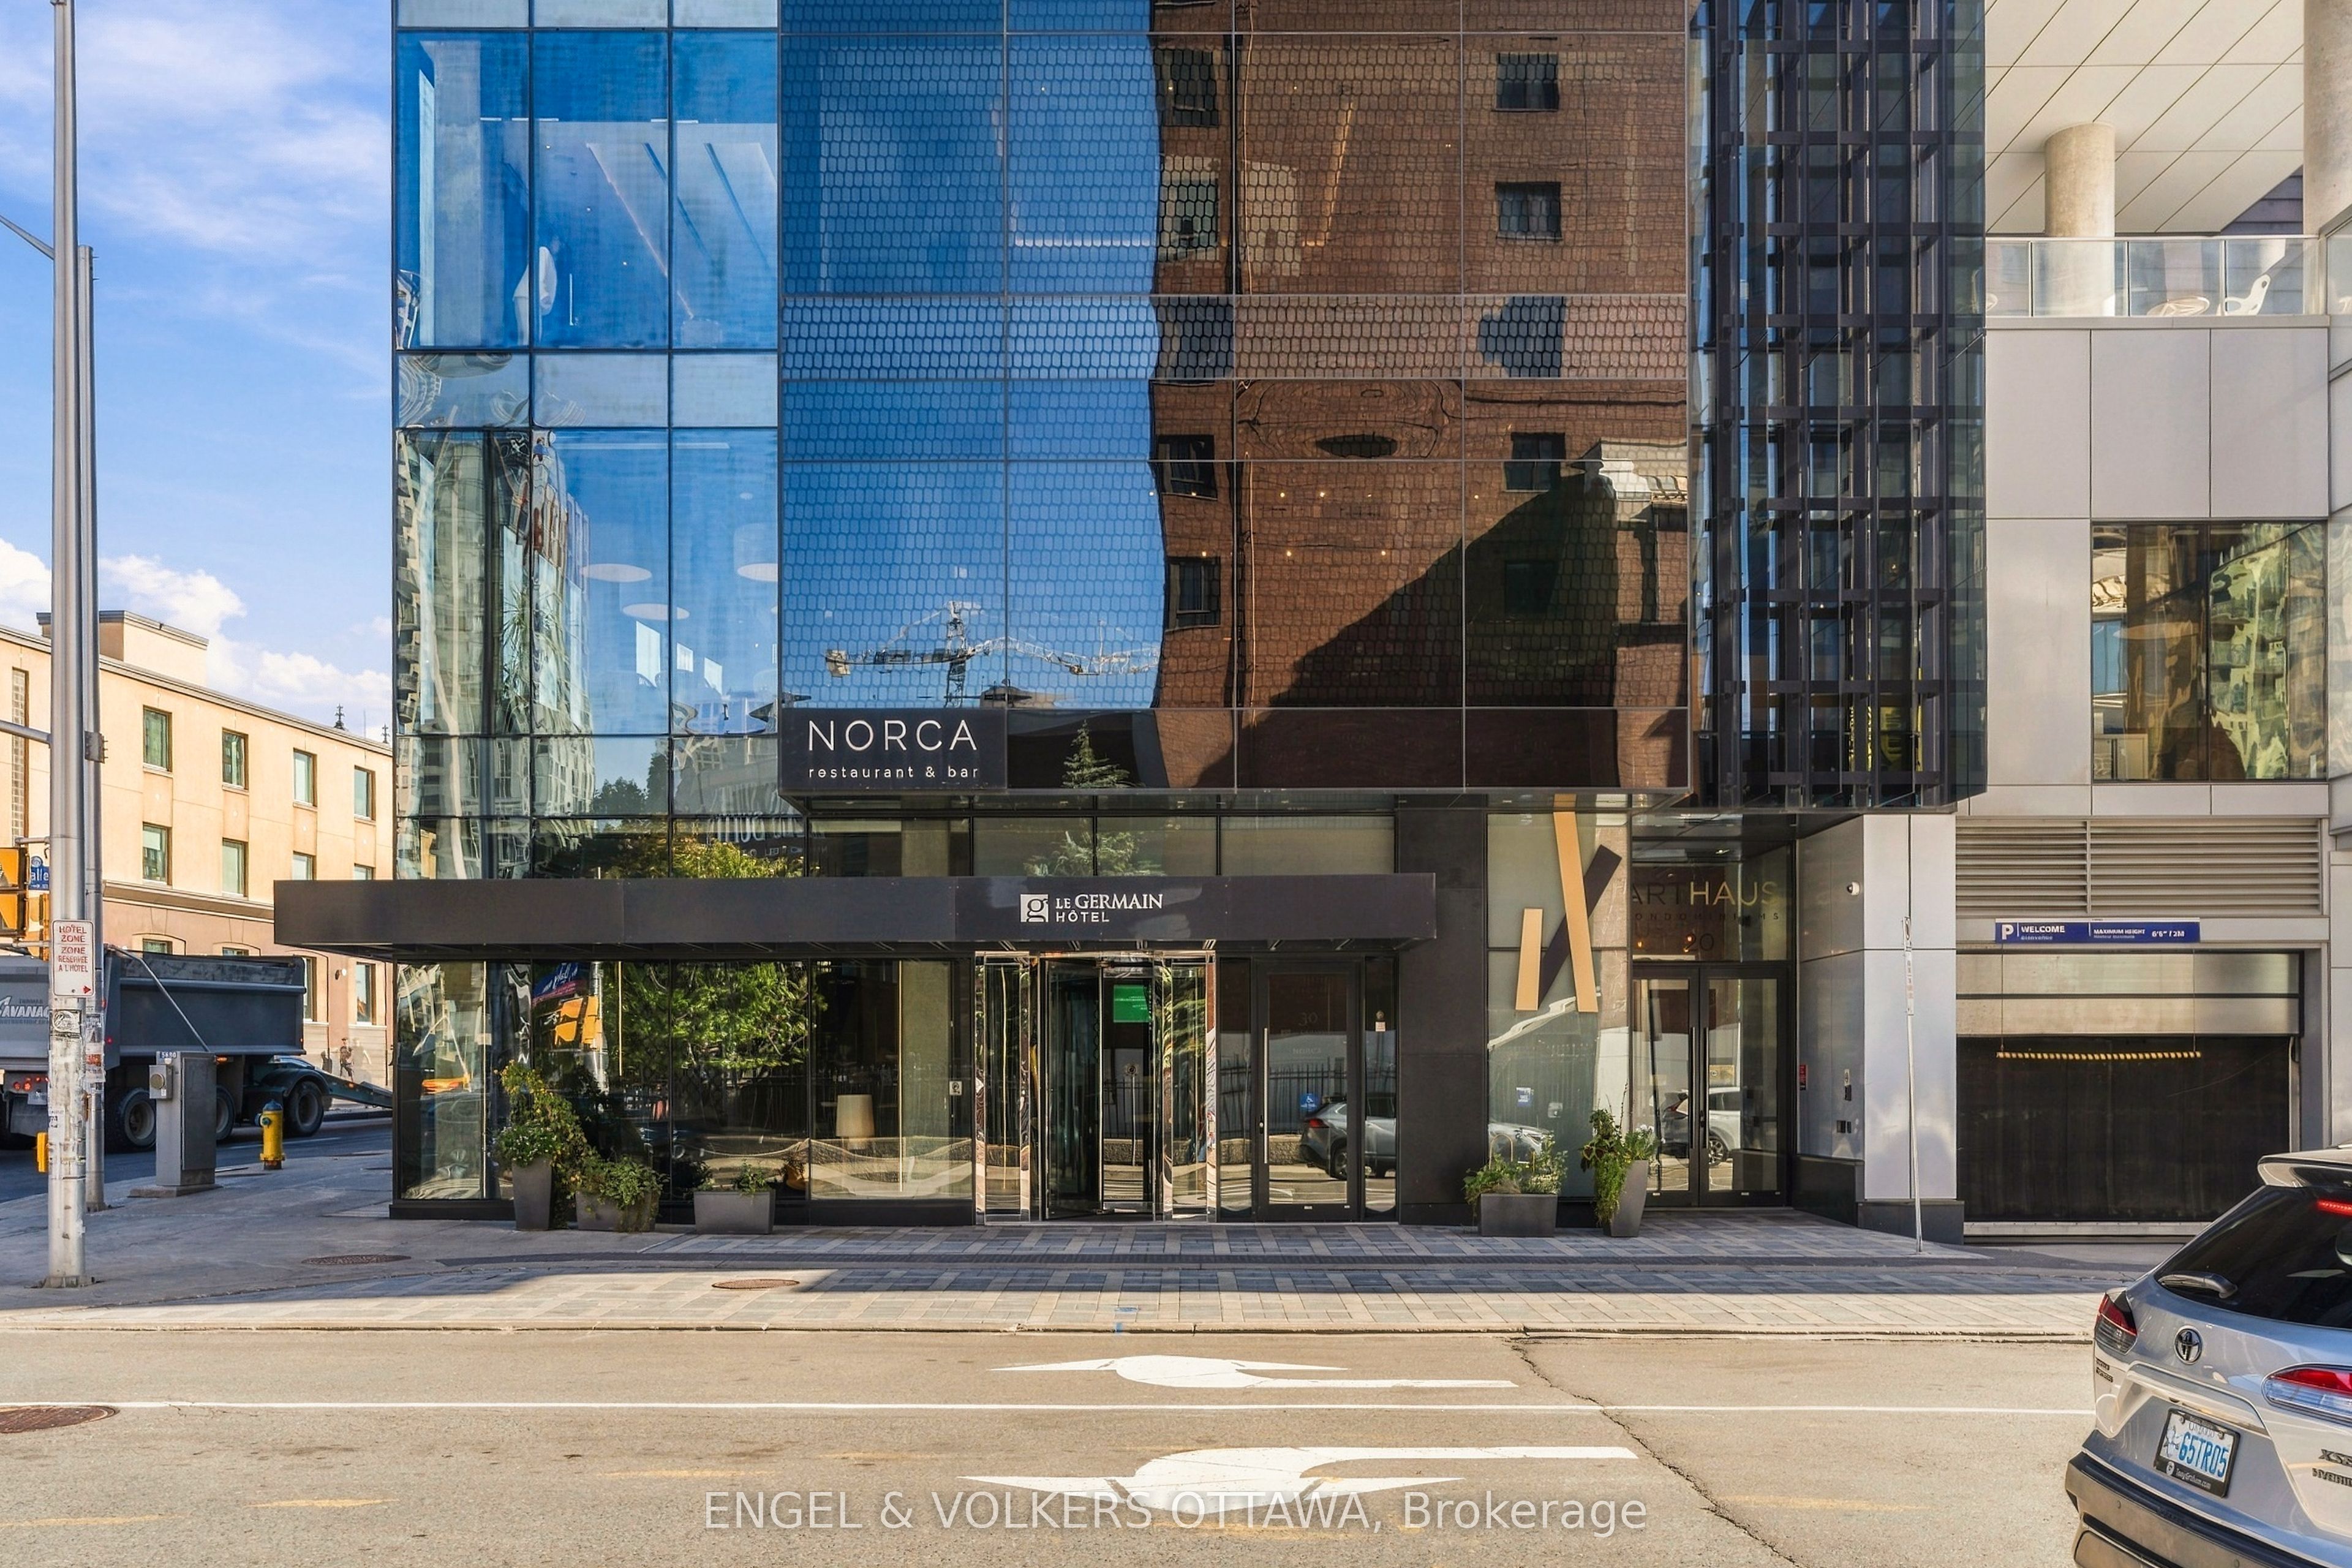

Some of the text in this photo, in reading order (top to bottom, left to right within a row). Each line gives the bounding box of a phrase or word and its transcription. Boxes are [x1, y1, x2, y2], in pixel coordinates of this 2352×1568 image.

[809, 720, 978, 751] NORCA
[809, 766, 978, 778] restaurant & bar
[31, 869, 49, 881] alle
[1055, 894, 1163, 909] LE GERMAIN
[1056, 910, 1109, 922] HÔTEL
[59, 925, 87, 934] HOTEL
[2002, 924, 2014, 940] P
